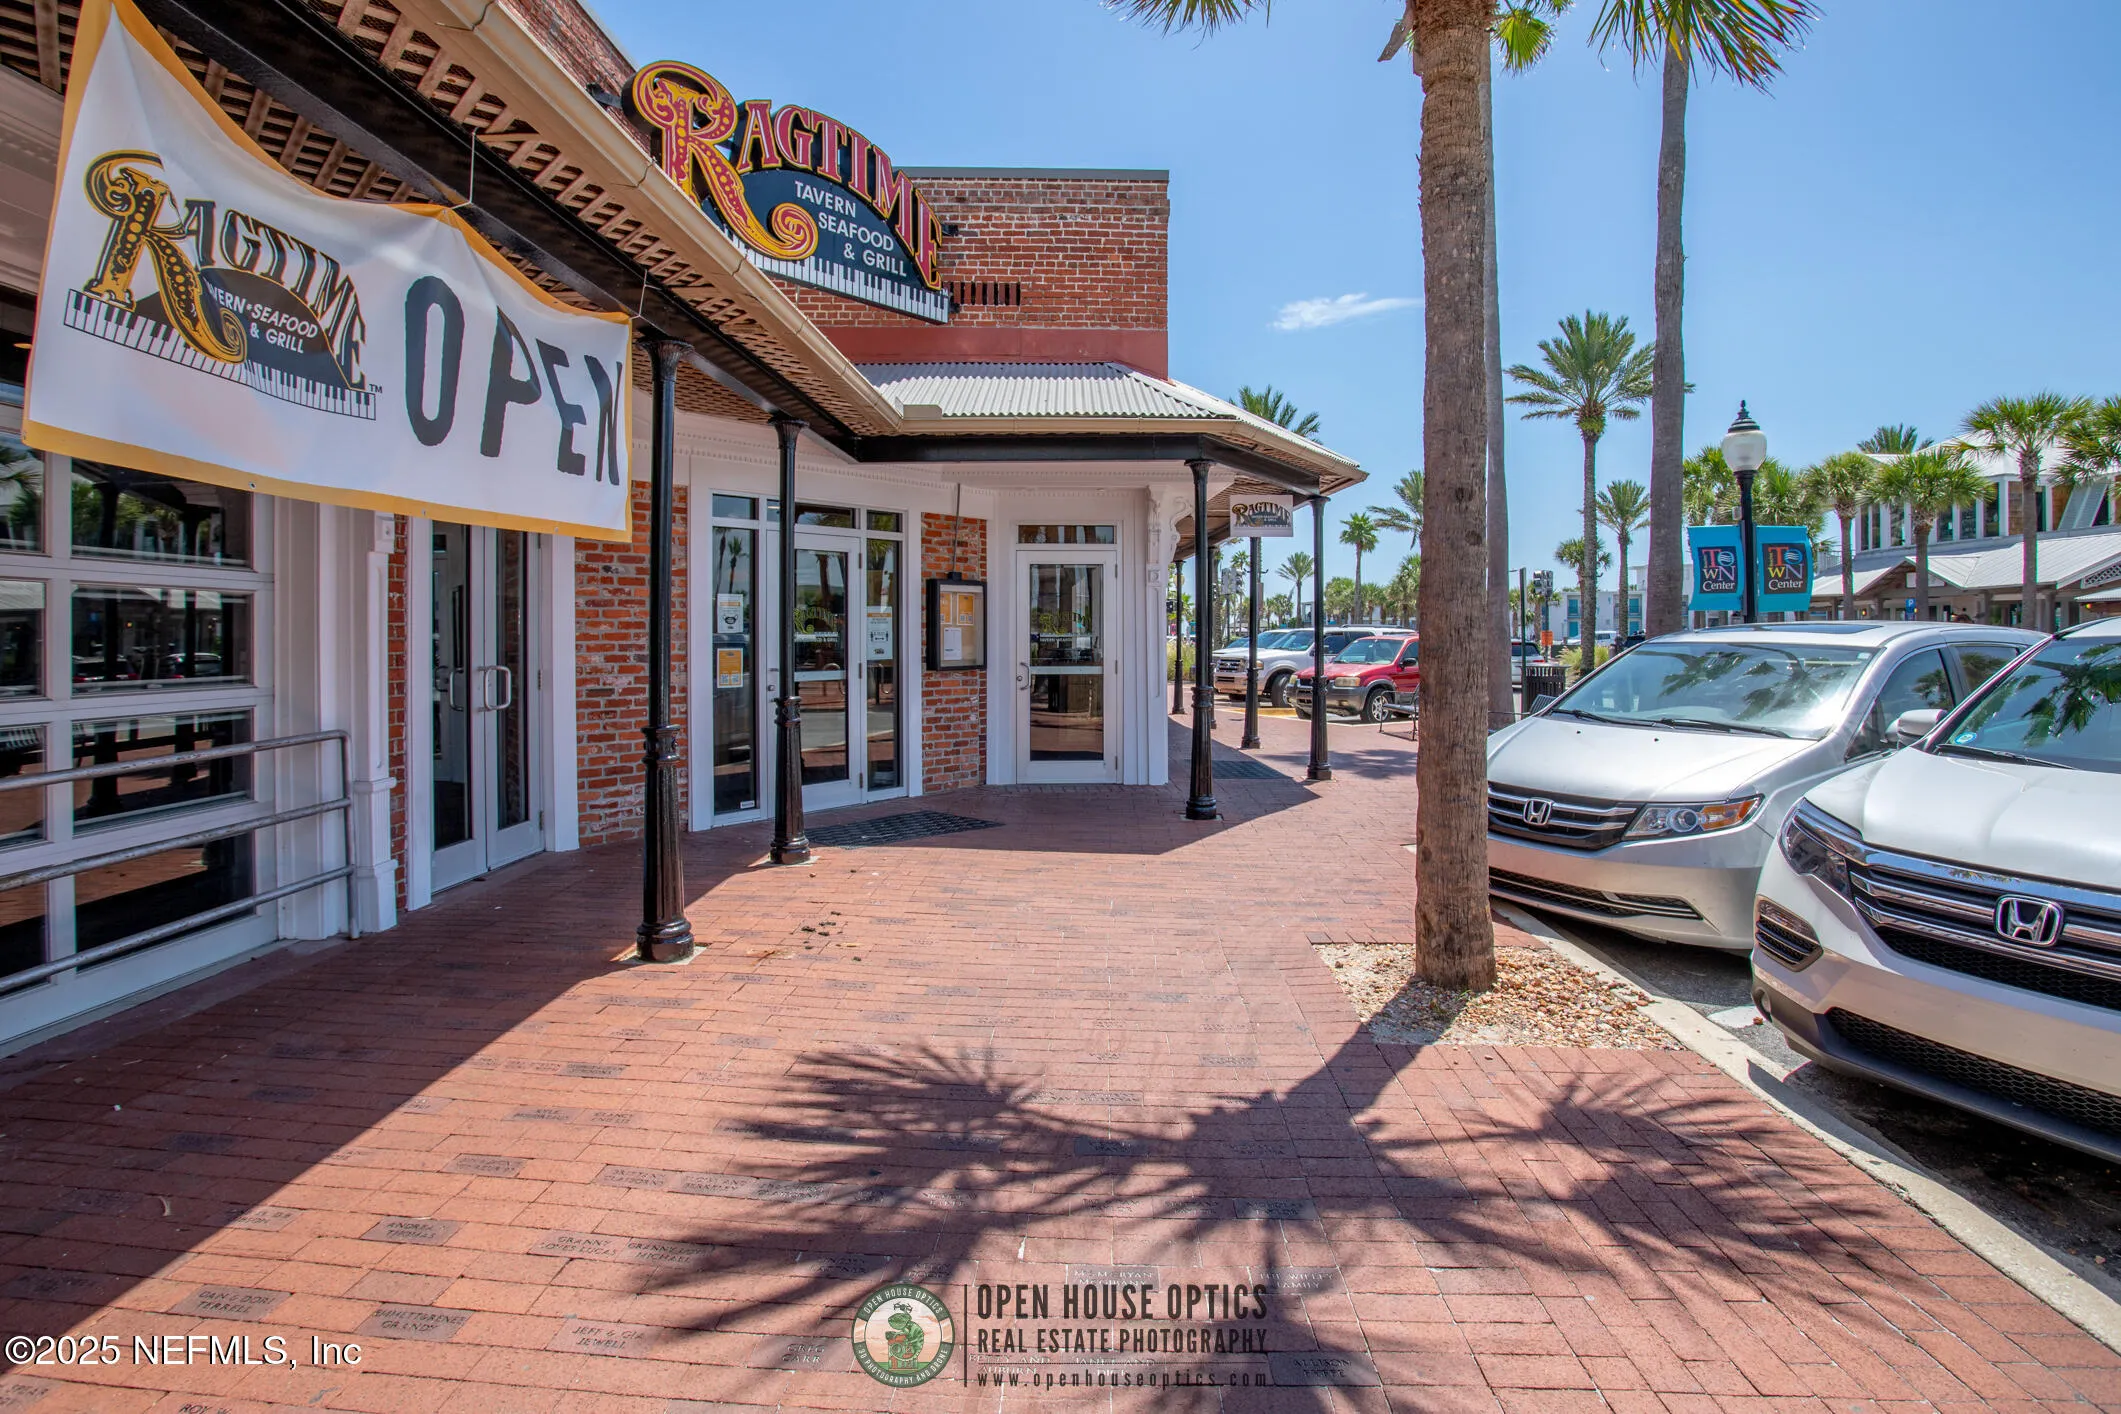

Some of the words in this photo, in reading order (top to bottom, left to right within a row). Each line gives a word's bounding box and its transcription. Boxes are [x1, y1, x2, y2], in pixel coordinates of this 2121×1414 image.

[633, 60, 942, 290] RAGTIME
[795, 180, 856, 218] TAVERN
[818, 213, 893, 252] SEAFOOD
[83, 149, 367, 392] RAGTIME
[843, 243, 856, 260] &
[862, 248, 907, 277] GRILL
[203, 278, 246, 313] VERN
[251, 303, 319, 338] SEAFOOD
[249, 322, 260, 338] &
[265, 326, 304, 354] GRILL
[369, 383, 383, 394] TM
[405, 276, 622, 486] OPEN
[1231, 502, 1291, 527] RAGTIME
[1703, 581, 1735, 591] Center
[1769, 580, 1803, 591] Center
[572, 1326, 602, 1336] JEFF
[575, 1338, 626, 1349] JEWELL
[781, 1354, 822, 1364] CARR
